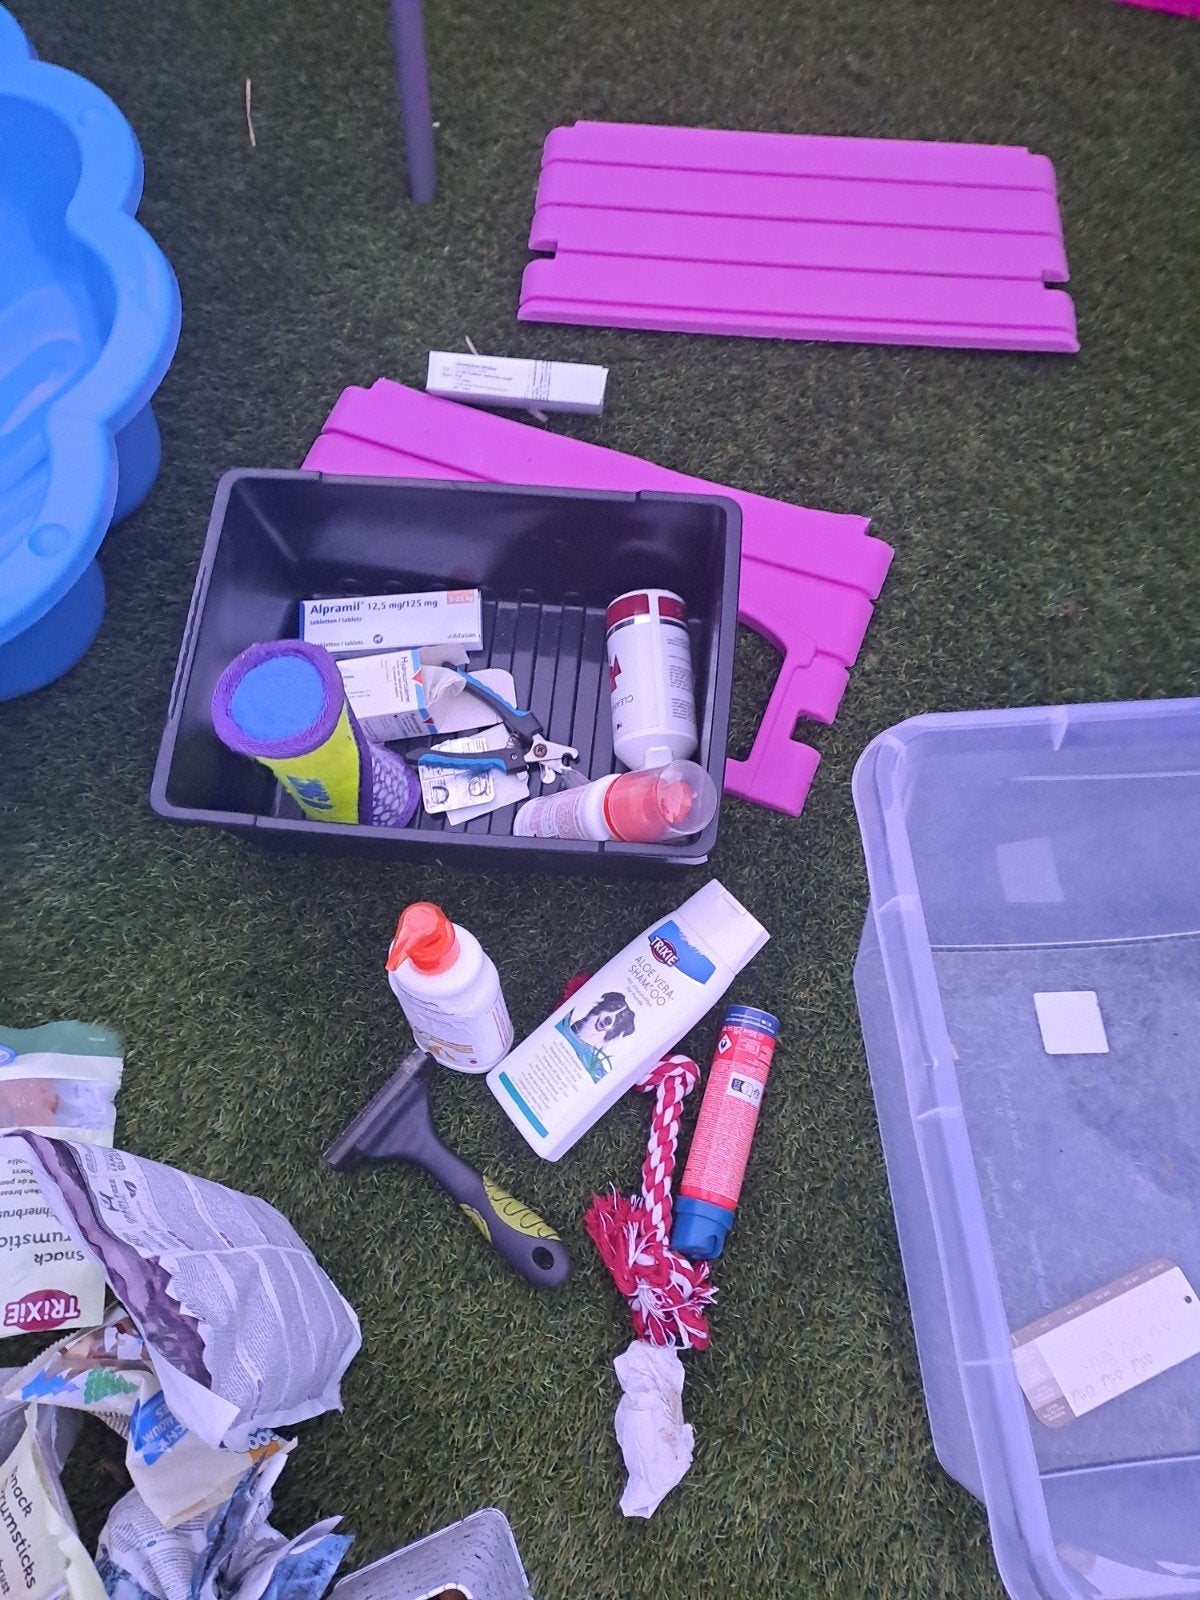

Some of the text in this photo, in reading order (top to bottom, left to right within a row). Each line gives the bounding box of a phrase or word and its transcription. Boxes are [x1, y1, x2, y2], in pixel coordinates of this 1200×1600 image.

[367, 602, 386, 612] 12,5
[388, 599, 422, 611] mg/125
[424, 599, 438, 609] mg
[634, 955, 656, 978] ALOE
[628, 964, 666, 1006] SHAMPOO
[34, 1250, 85, 1266] Snack
[8, 1472, 33, 1518] nack
[0, 1490, 36, 1590] rumsticks
